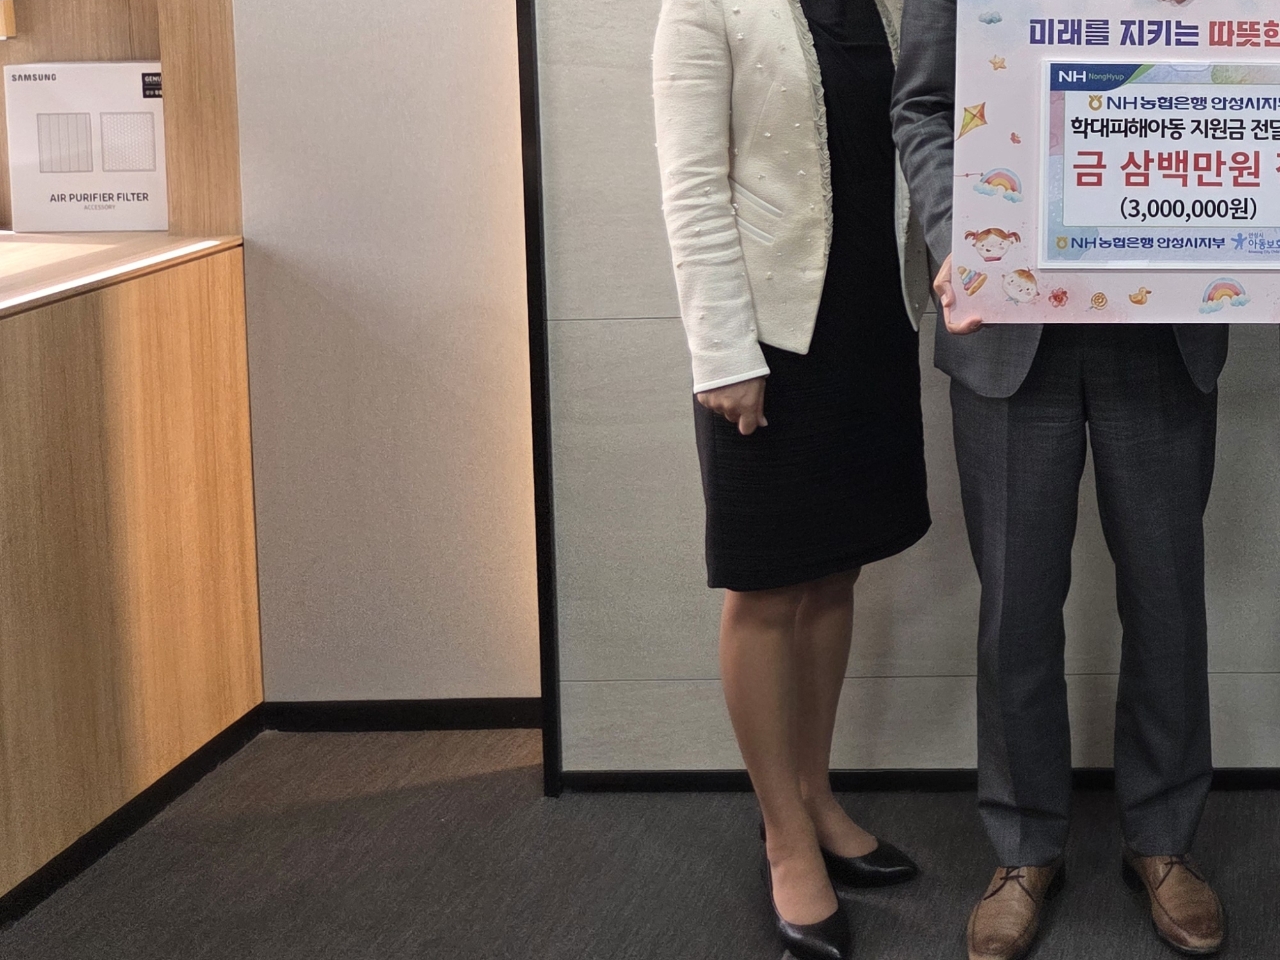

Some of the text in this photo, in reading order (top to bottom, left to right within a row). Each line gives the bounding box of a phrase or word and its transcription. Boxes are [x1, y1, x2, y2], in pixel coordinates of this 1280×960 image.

[1029, 19, 1109, 46] 미래를
[1120, 19, 1199, 46] 지키는
[11, 73, 57, 82] SAMSUNG
[1058, 70, 1125, 83] NH NongHyup
[1070, 116, 1186, 140] 학대피해아동
[1190, 118, 1247, 141] 지원금
[1073, 150, 1107, 187] 금
[1120, 149, 1261, 188] 삼백만원
[50, 192, 149, 203] AIR PURIFIER FILTER
[1120, 196, 1258, 222] (3,000,000원)
[1156, 237, 1226, 249] 안성시지부
